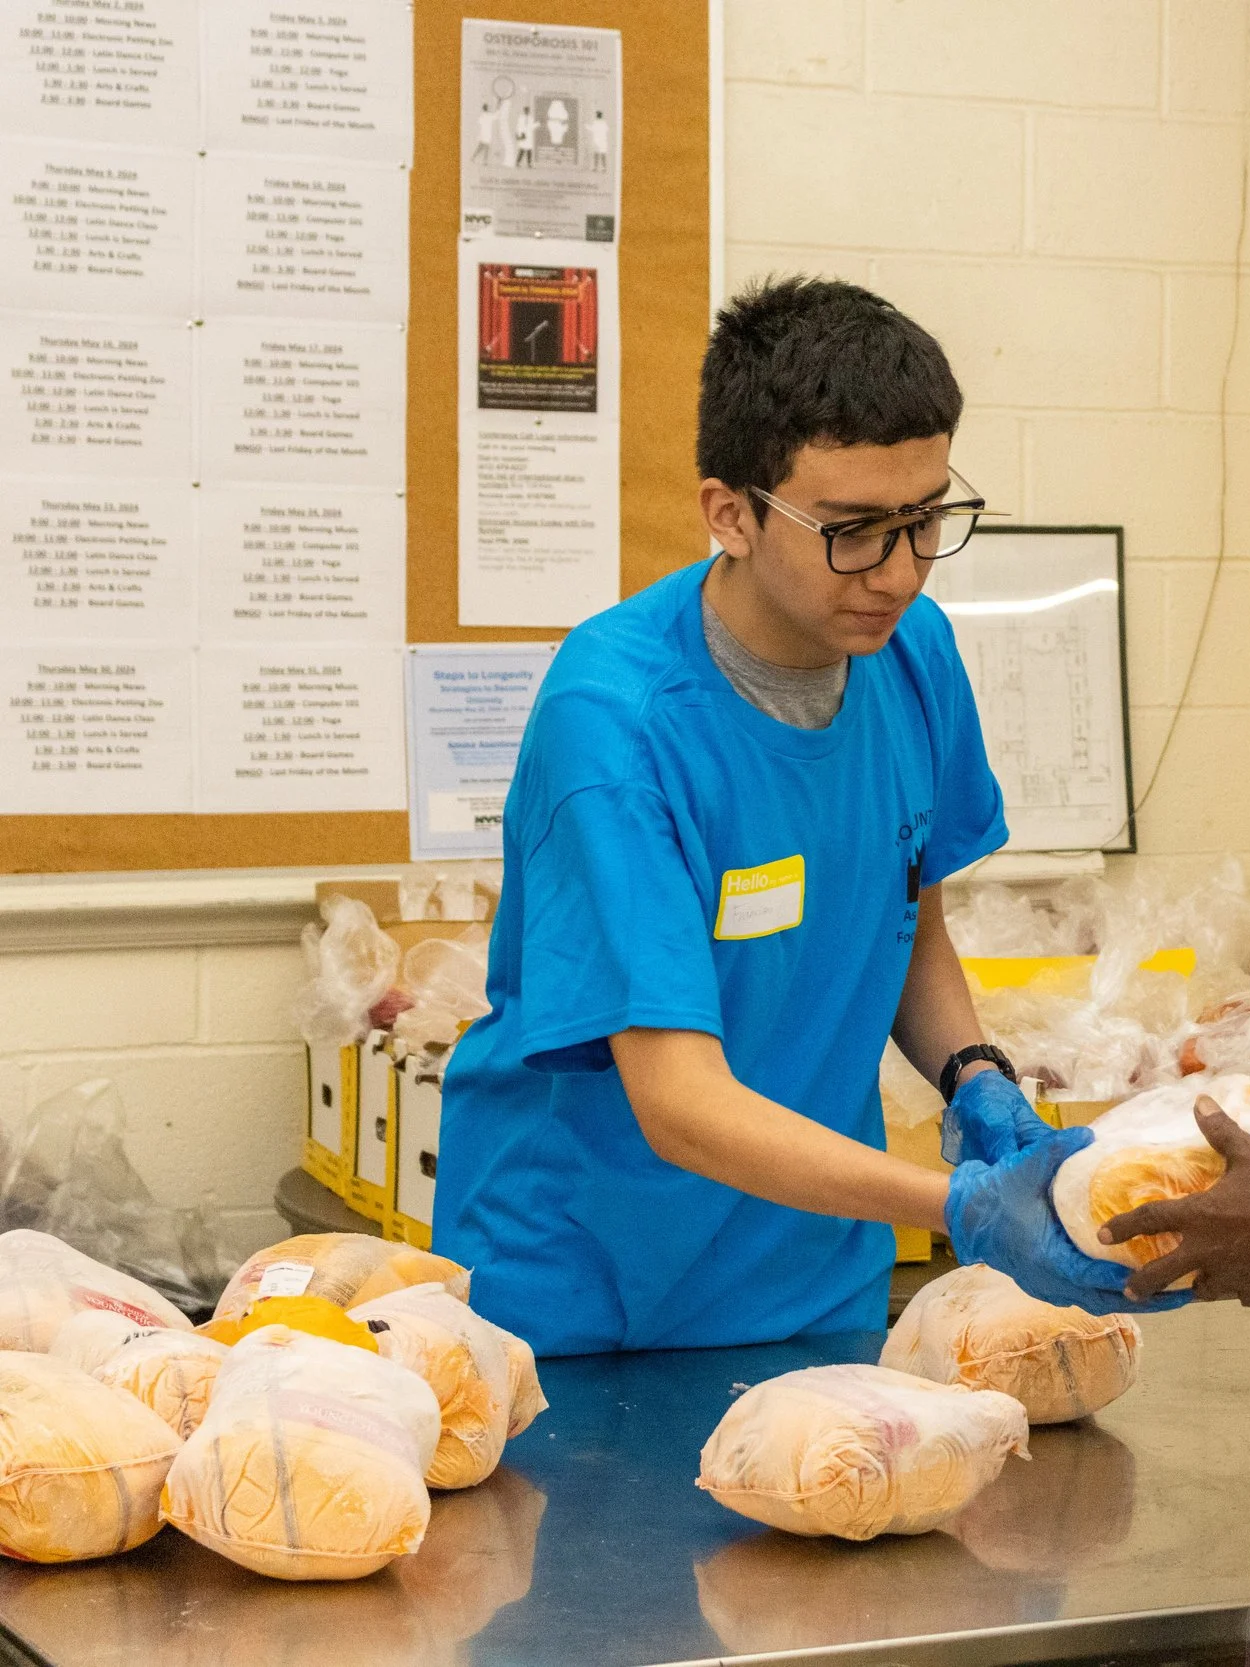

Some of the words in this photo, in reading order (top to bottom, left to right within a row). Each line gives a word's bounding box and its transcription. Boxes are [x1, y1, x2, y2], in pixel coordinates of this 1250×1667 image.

[464, 214, 492, 225] NYC
[434, 670, 464, 681] Steps
[468, 671, 478, 680] to
[482, 670, 533, 681] Longevity
[474, 816, 502, 824] NYC
[727, 871, 769, 893] Hello
